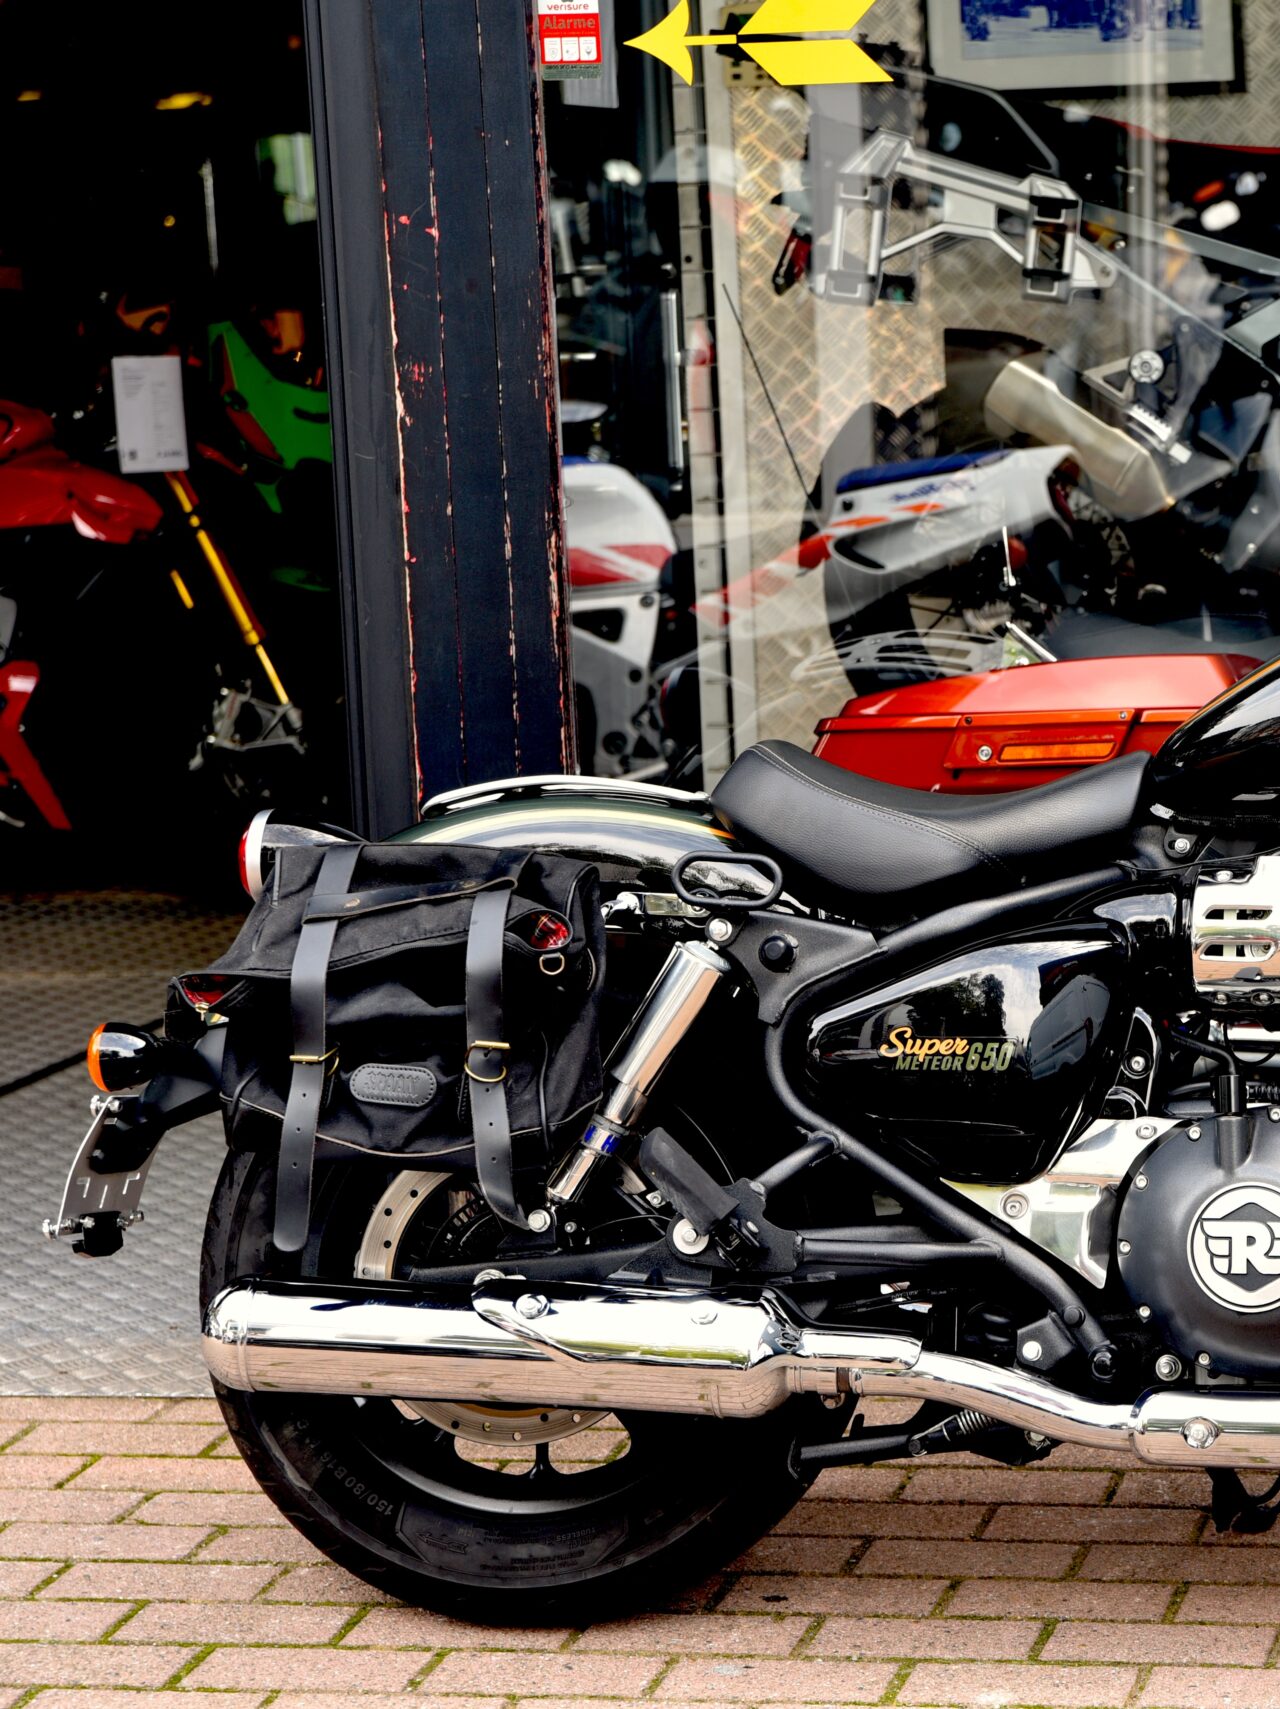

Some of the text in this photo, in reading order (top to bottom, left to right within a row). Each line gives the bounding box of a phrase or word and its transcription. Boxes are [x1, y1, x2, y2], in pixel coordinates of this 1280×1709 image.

[546, 3, 590, 11] verisure
[543, 16, 596, 30] Alarme
[879, 1026, 970, 1063] Super
[895, 1041, 1016, 1072] METEOR 650
